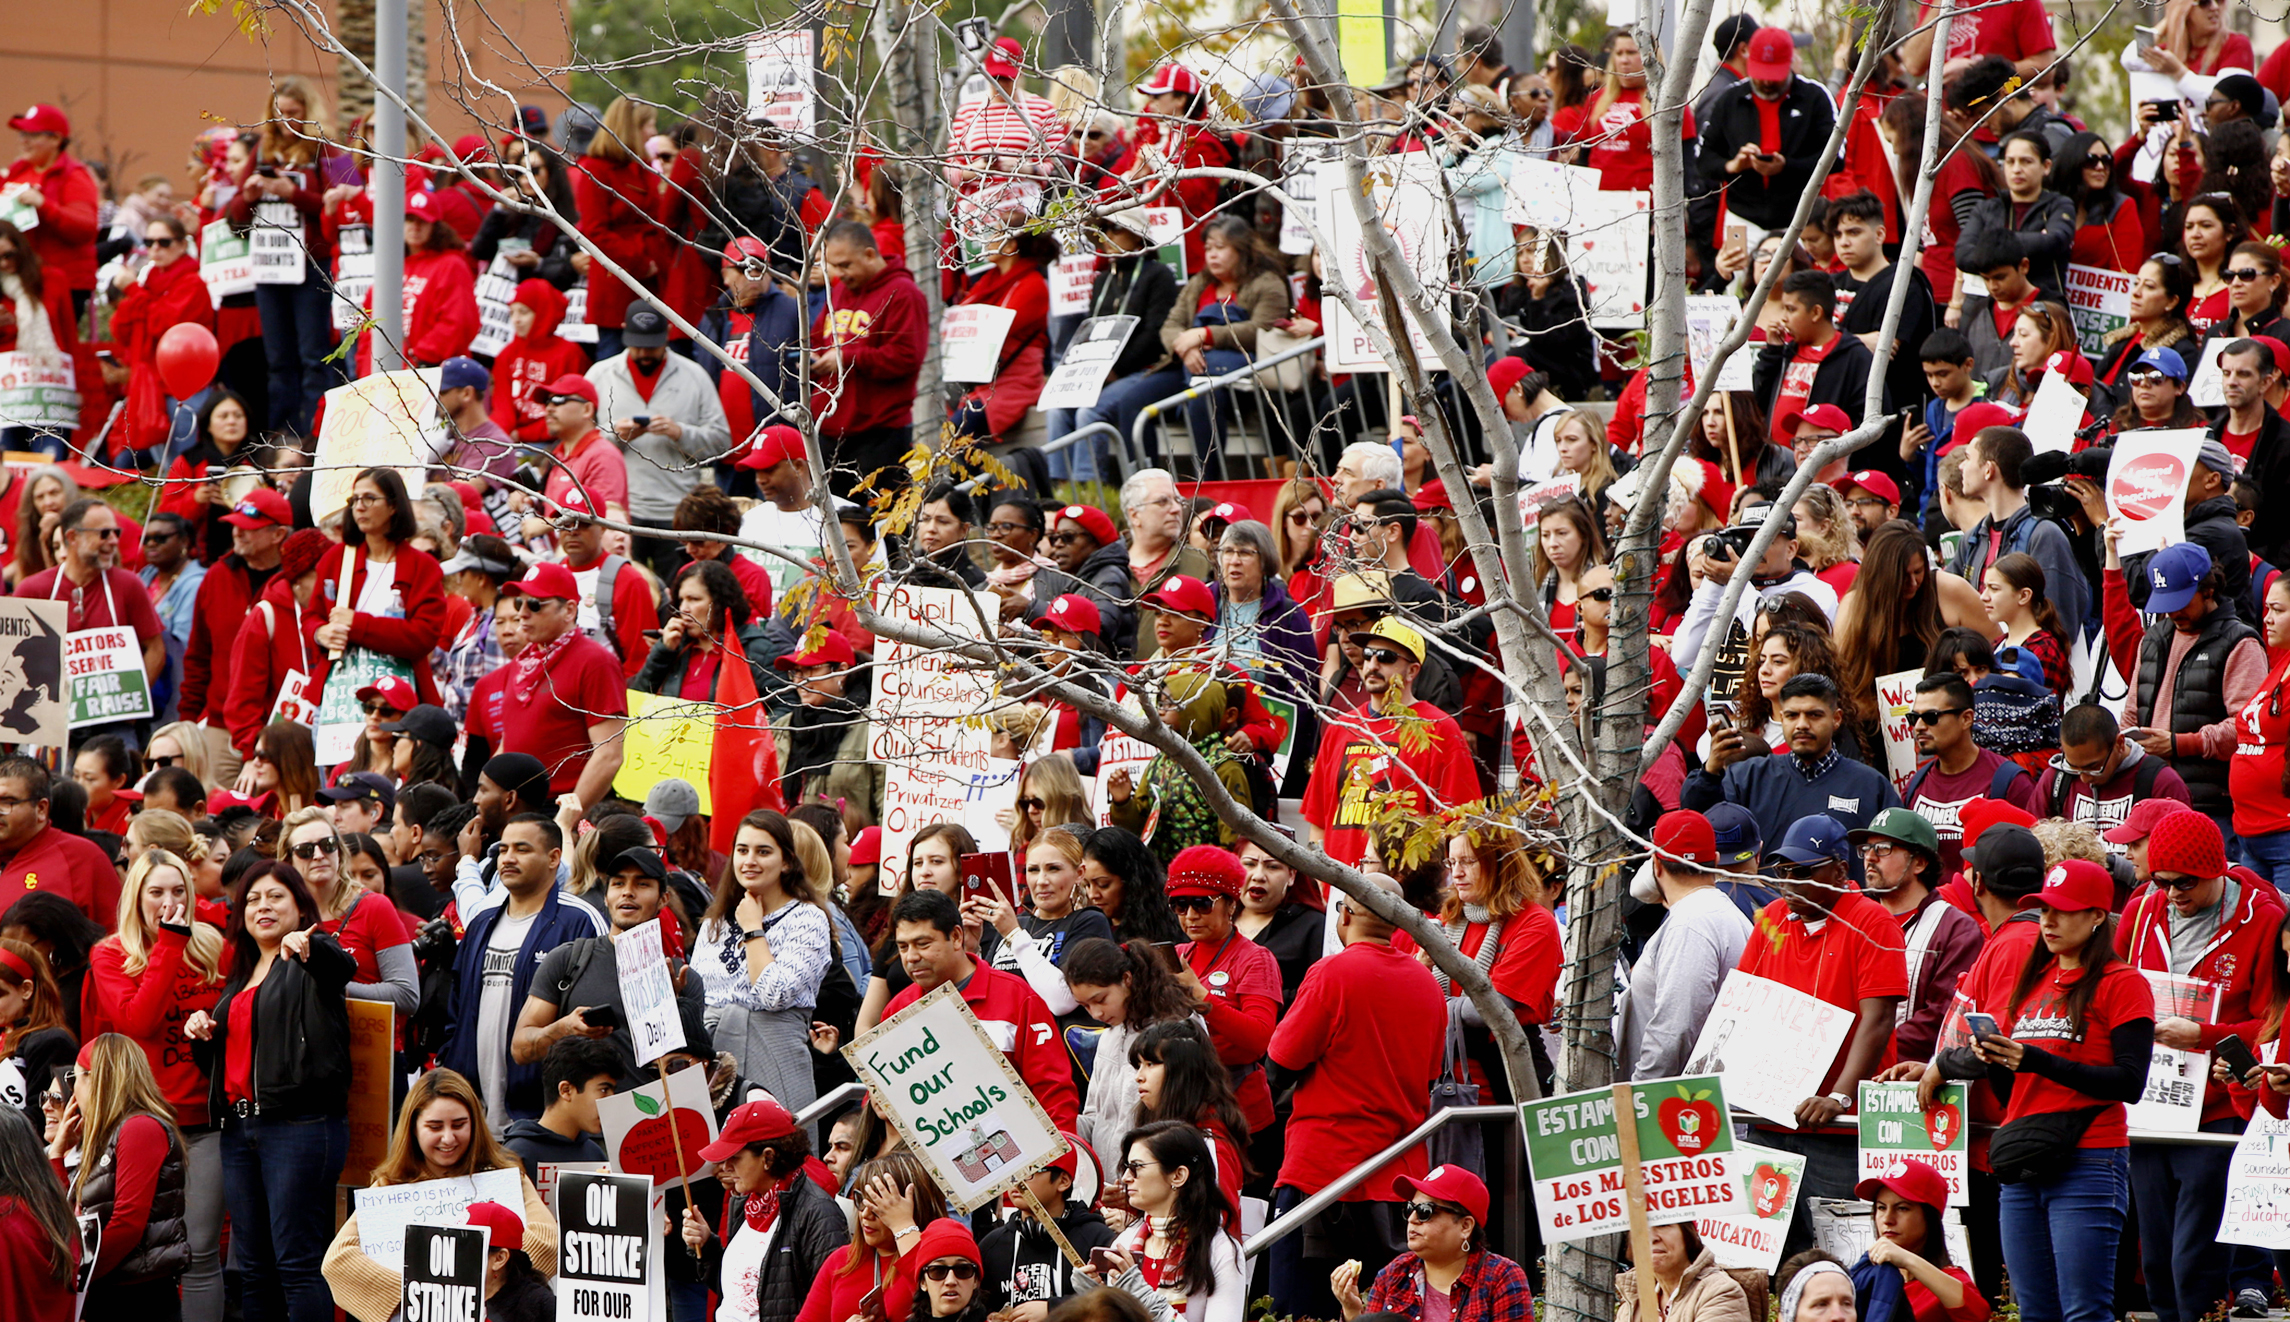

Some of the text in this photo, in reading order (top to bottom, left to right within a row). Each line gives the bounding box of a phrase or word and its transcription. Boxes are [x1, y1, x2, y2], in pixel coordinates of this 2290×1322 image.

[252, 252, 295, 266] TUDENTS
[2068, 269, 2130, 294] TUDENTS
[2152, 567, 2168, 588] LA
[66, 632, 126, 655] CATORS
[68, 655, 114, 675] SERVE
[74, 673, 122, 699] FAIR
[881, 672, 983, 706] Counselors
[1882, 681, 1914, 707] We
[85, 691, 144, 717] RAISE
[886, 781, 965, 812] Privatizers
[1919, 801, 1964, 826] HOMEBO
[867, 1026, 941, 1087] Fund
[909, 1061, 954, 1105] our
[915, 1084, 1007, 1147] Schools
[1536, 1091, 1701, 1143] ESTAMS UTLA
[623, 1129, 691, 1157] SUPPORTIG
[1878, 1119, 1903, 1144] CON
[1570, 1133, 1621, 1166] CON
[1866, 1152, 1885, 1169] Los
[362, 1186, 458, 1208] MY HERO IS MY
[1551, 1180, 1593, 1202] Los
[585, 1182, 618, 1228] ON
[1553, 1182, 1735, 1228] de LOS NGELES
[364, 1242, 384, 1256] MY
[429, 1234, 457, 1278] ON
[564, 1230, 644, 1279] STRIKE
[1018, 1264, 1041, 1276] THE
[407, 1280, 478, 1322] STRIKE
[573, 1288, 632, 1320] FOR OUR
[1013, 1287, 1041, 1303] FACE
